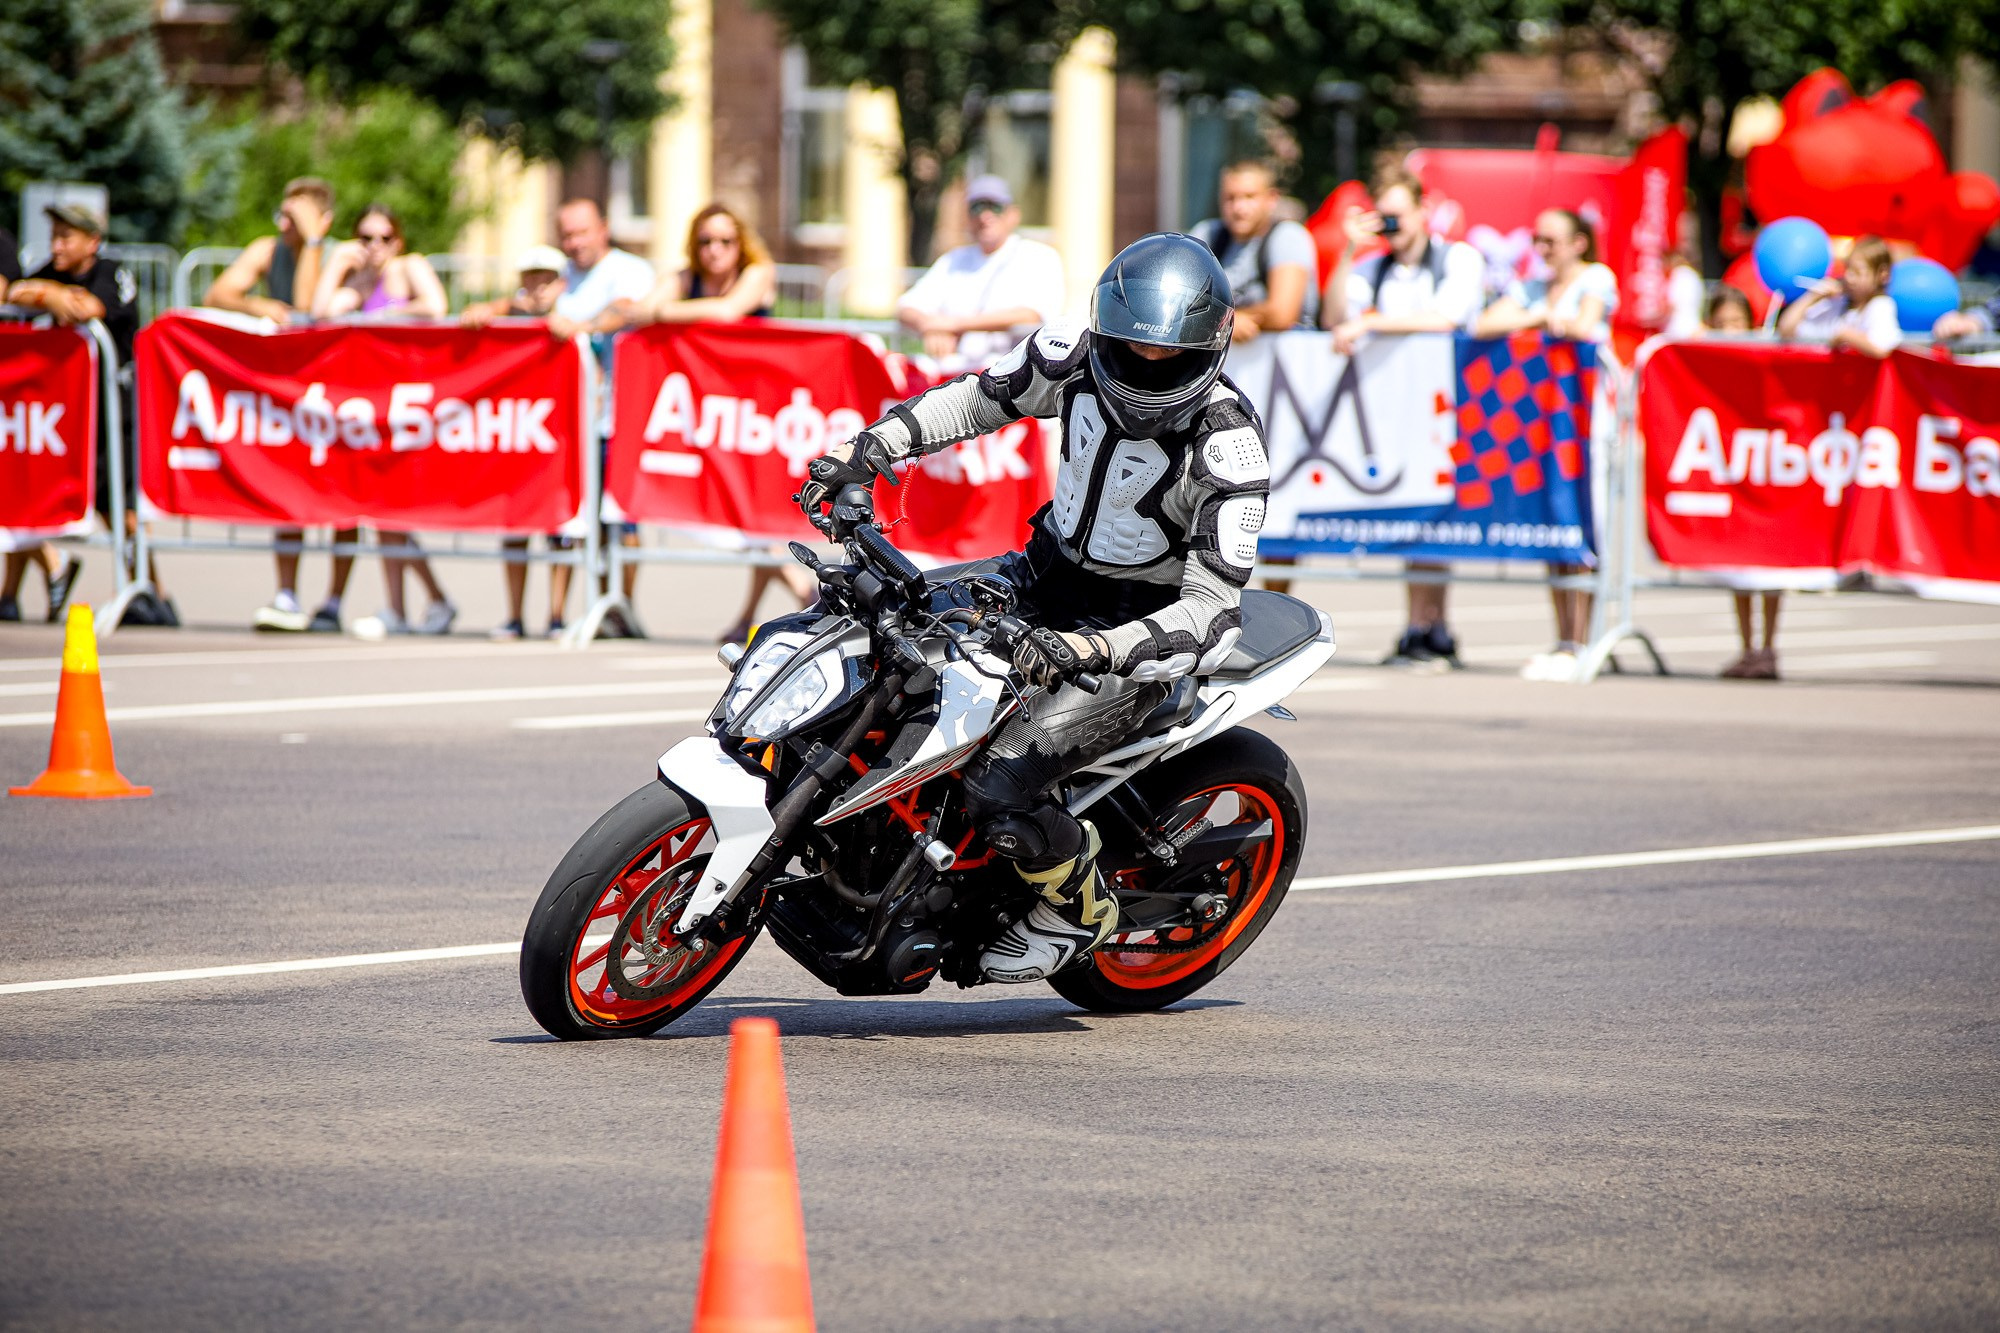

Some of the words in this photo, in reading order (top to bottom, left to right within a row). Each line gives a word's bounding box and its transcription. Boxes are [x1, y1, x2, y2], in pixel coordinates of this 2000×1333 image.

[1049, 339, 1071, 350] FOX
[1133, 321, 1173, 337] NOLAN
[172, 369, 382, 466] Альфа
[387, 382, 558, 453] Банк
[1668, 407, 1900, 507] Альфа
